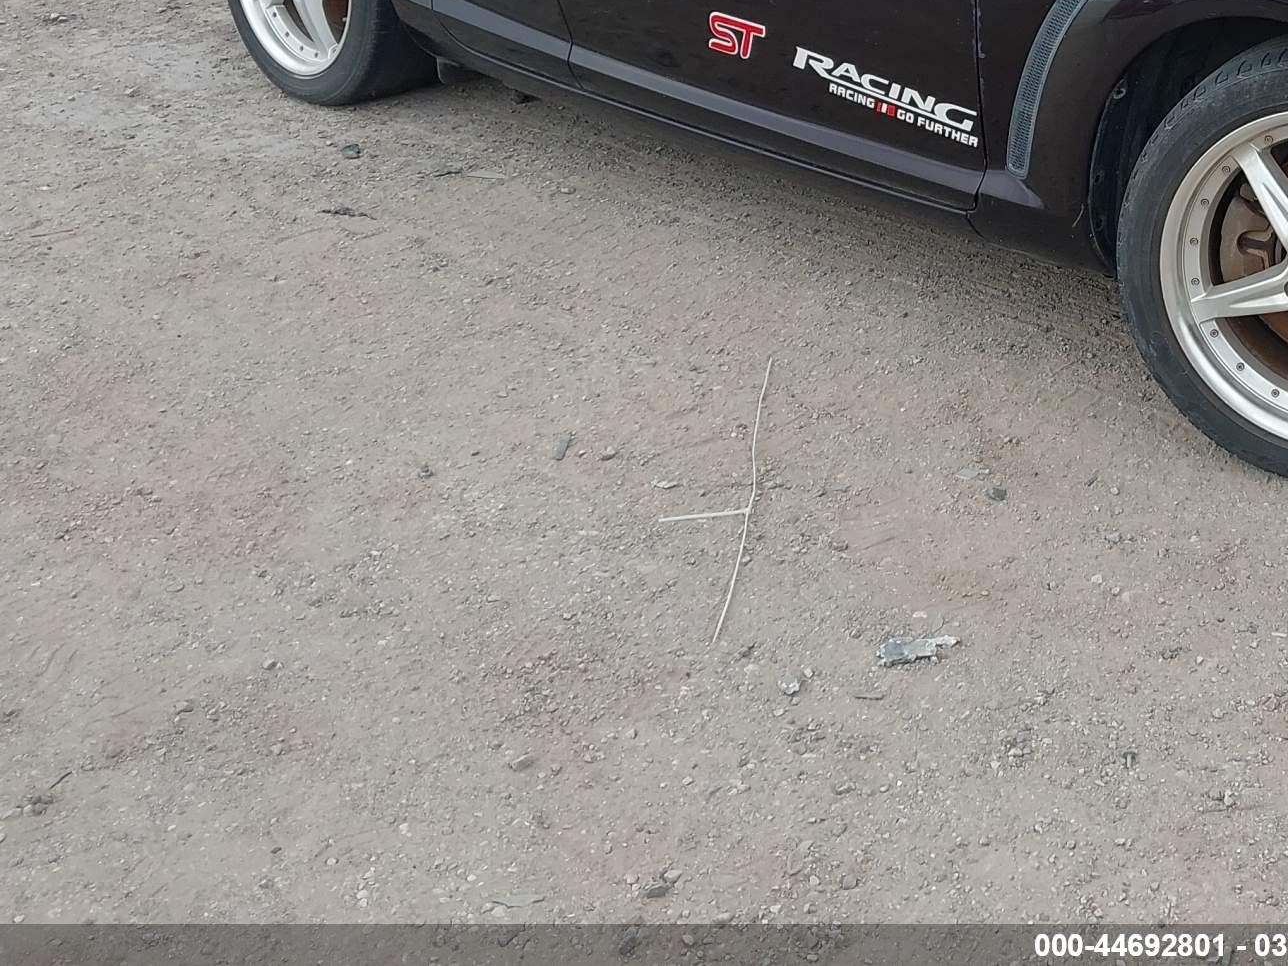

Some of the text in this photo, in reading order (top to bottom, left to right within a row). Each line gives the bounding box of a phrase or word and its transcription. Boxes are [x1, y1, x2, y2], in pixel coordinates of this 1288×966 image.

[708, 11, 766, 60] ST
[793, 46, 978, 132] RACING
[828, 83, 979, 148] RACING GO FURTHER
